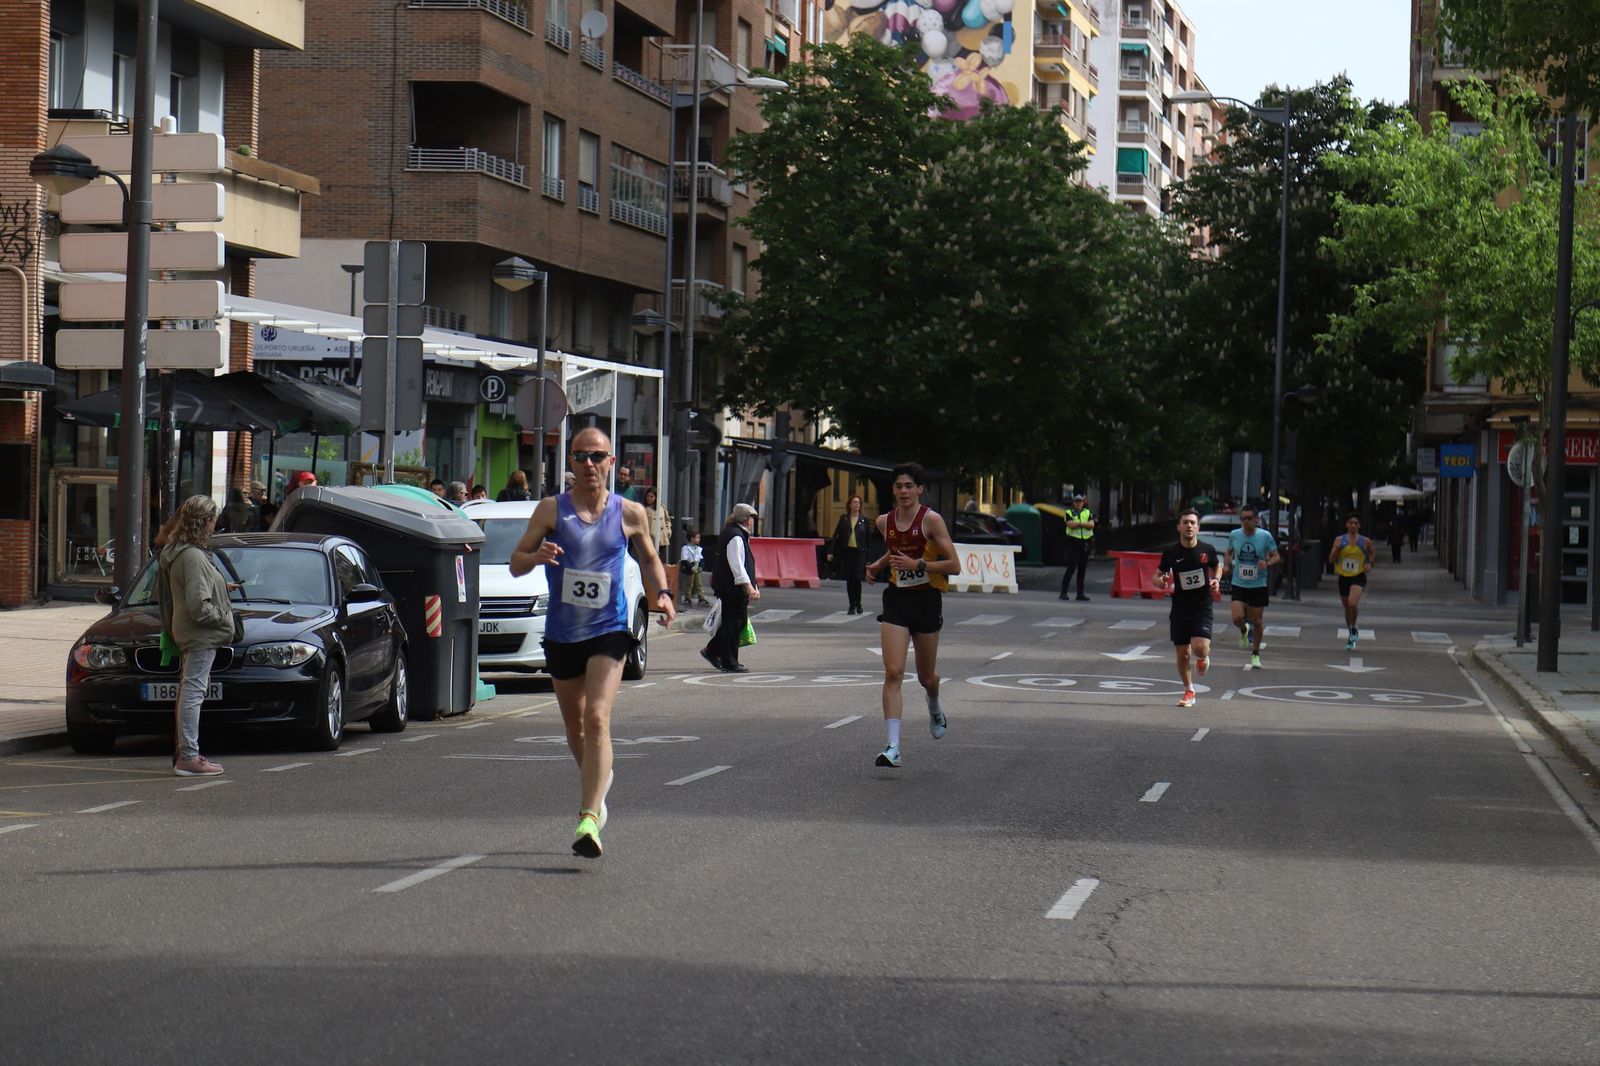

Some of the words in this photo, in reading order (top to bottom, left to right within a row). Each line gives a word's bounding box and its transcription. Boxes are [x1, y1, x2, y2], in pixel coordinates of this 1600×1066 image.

[1185, 575, 1200, 585] 32
[572, 581, 599, 599] 33
[153, 685, 177, 699] 186
